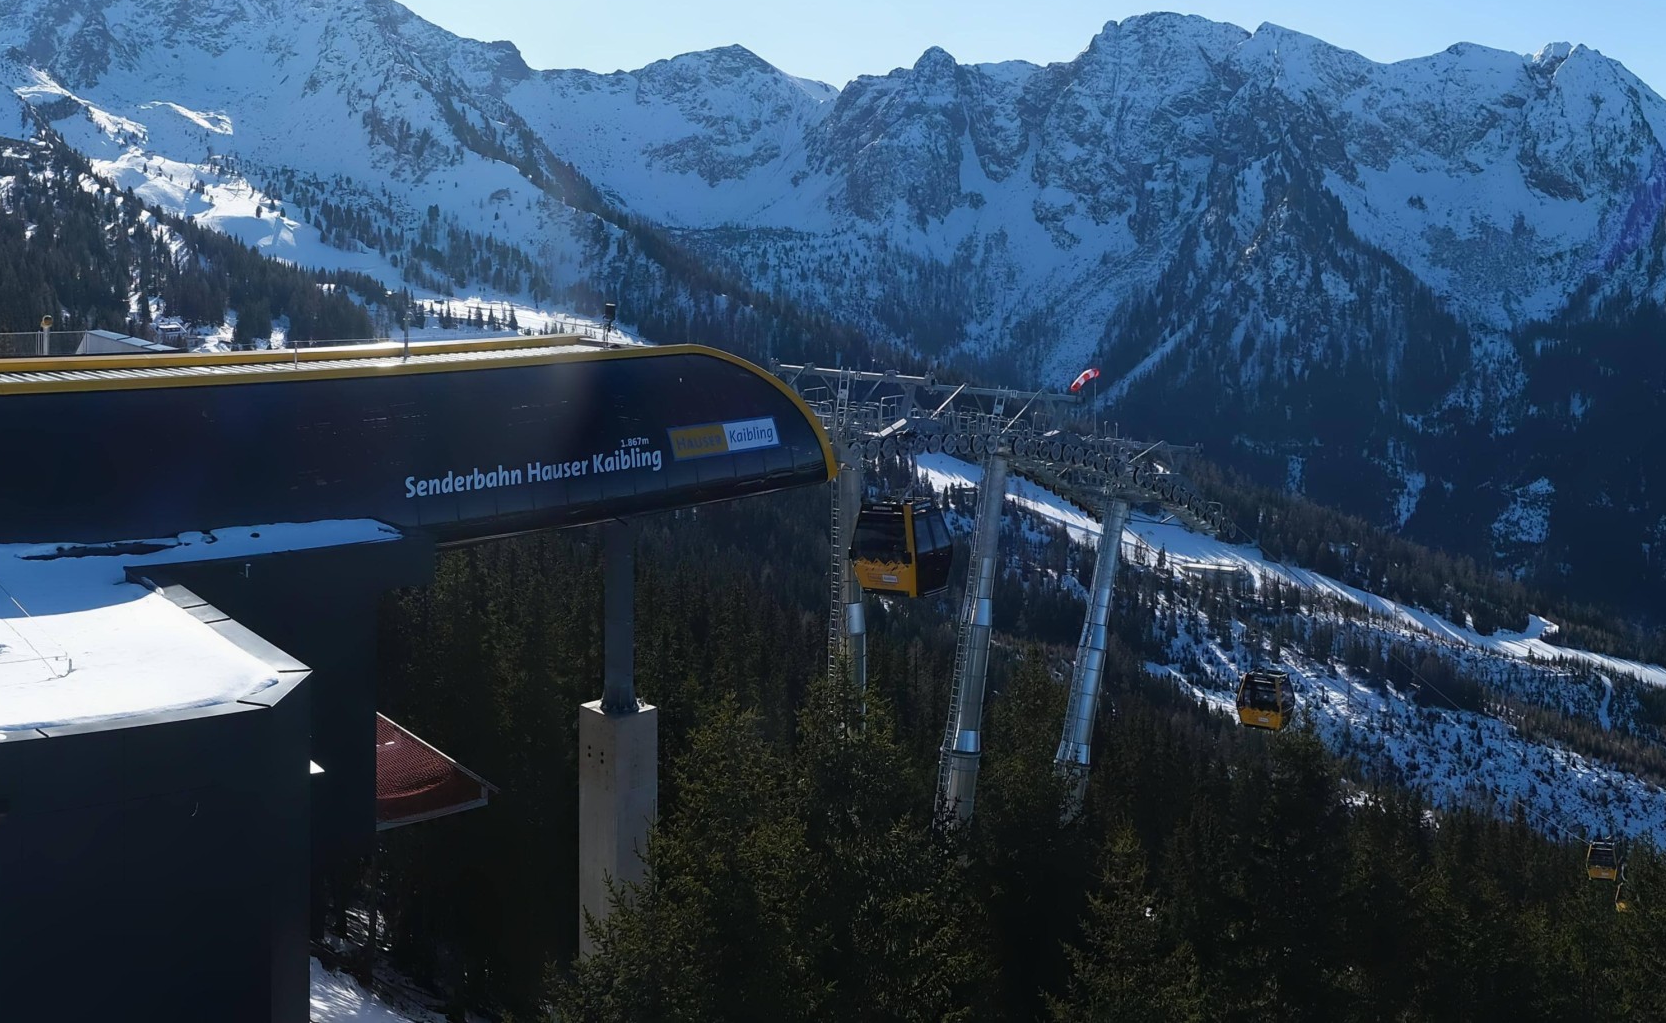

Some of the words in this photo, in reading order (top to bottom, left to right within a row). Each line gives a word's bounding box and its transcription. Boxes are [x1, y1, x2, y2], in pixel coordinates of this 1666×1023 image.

[620, 437, 650, 448] 1.867m
[675, 434, 722, 451] HAUSER
[729, 425, 774, 444] Kaibling
[405, 464, 522, 498] Senderbahn
[527, 459, 589, 484] Hauser
[592, 447, 662, 474] Kaibling
